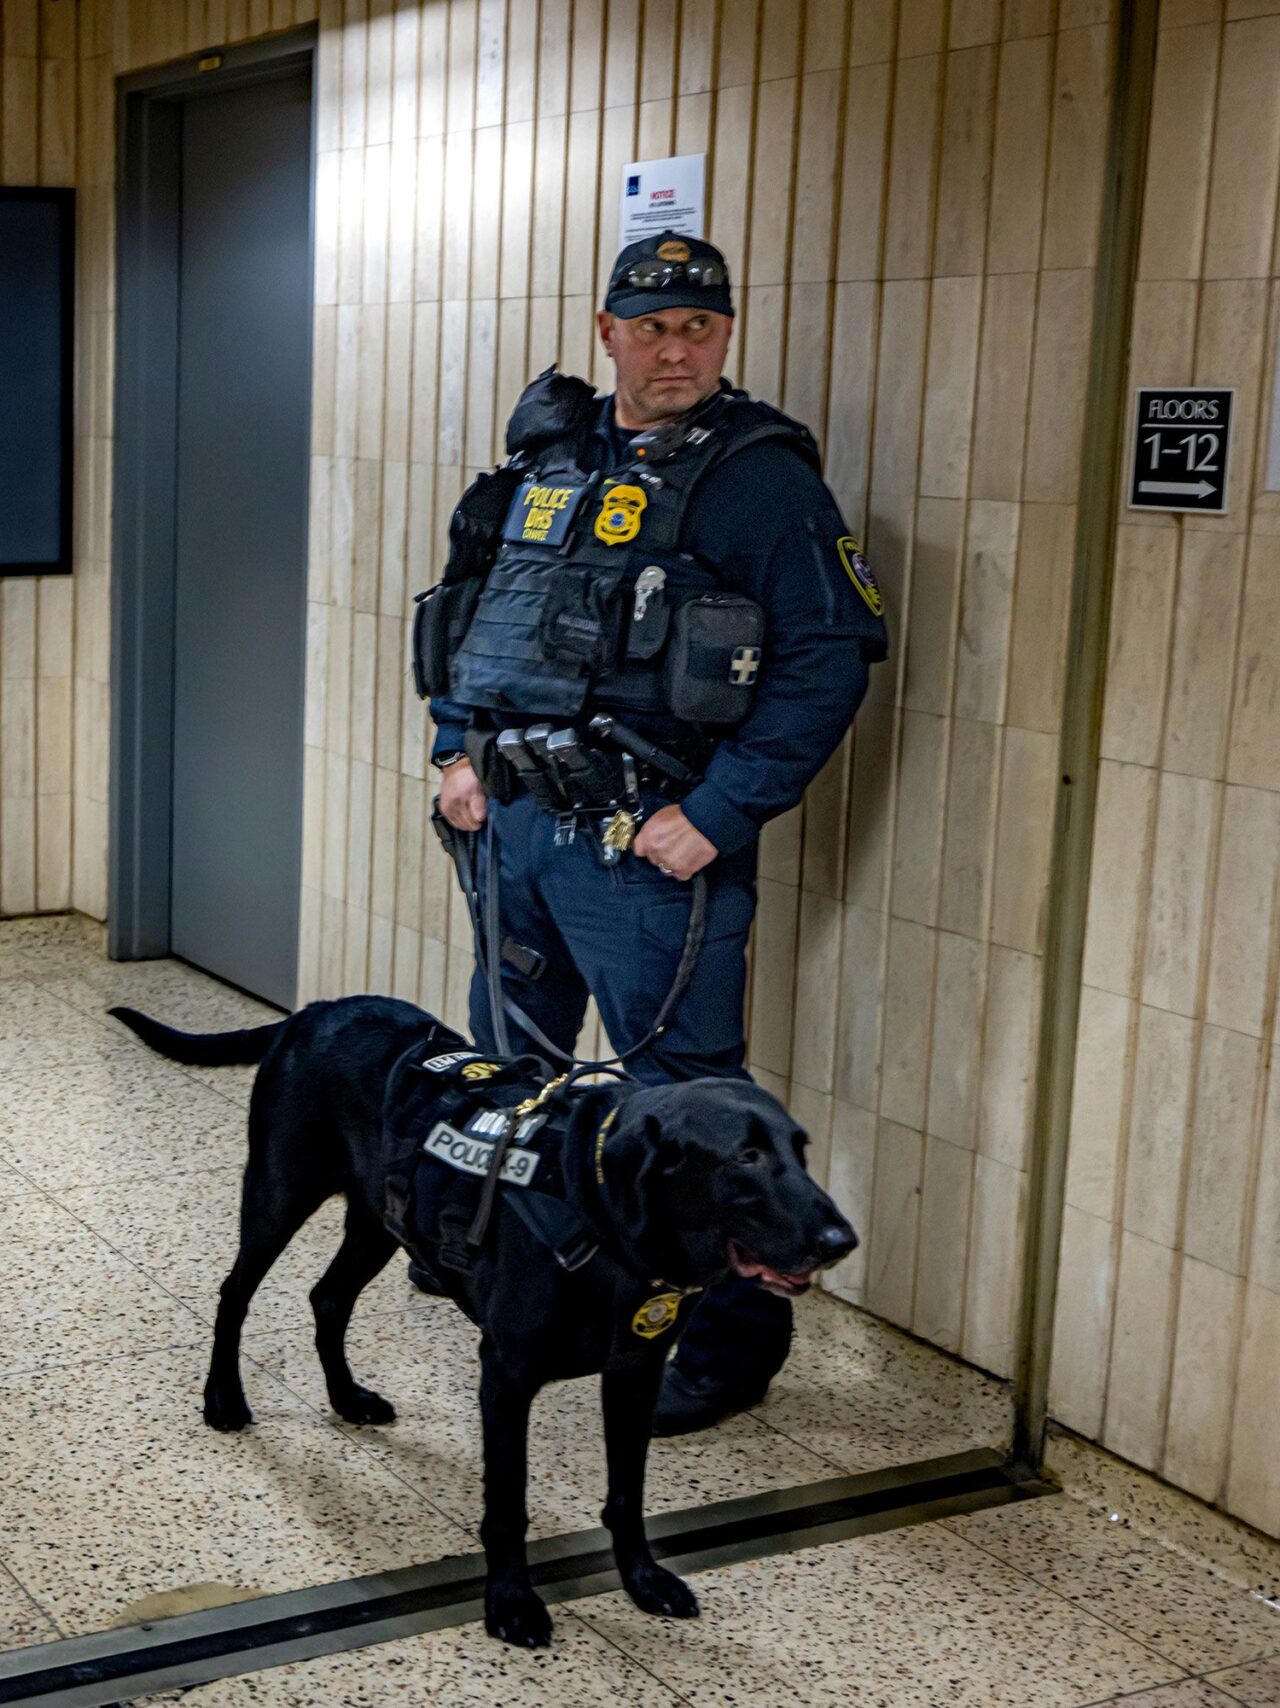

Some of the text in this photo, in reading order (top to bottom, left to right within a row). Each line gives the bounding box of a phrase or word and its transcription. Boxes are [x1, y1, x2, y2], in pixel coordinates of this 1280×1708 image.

[1148, 399, 1220, 420] FLOORS
[1143, 432, 1220, 472] 1-12
[523, 486, 574, 510] POLICE
[523, 507, 556, 530] DHS
